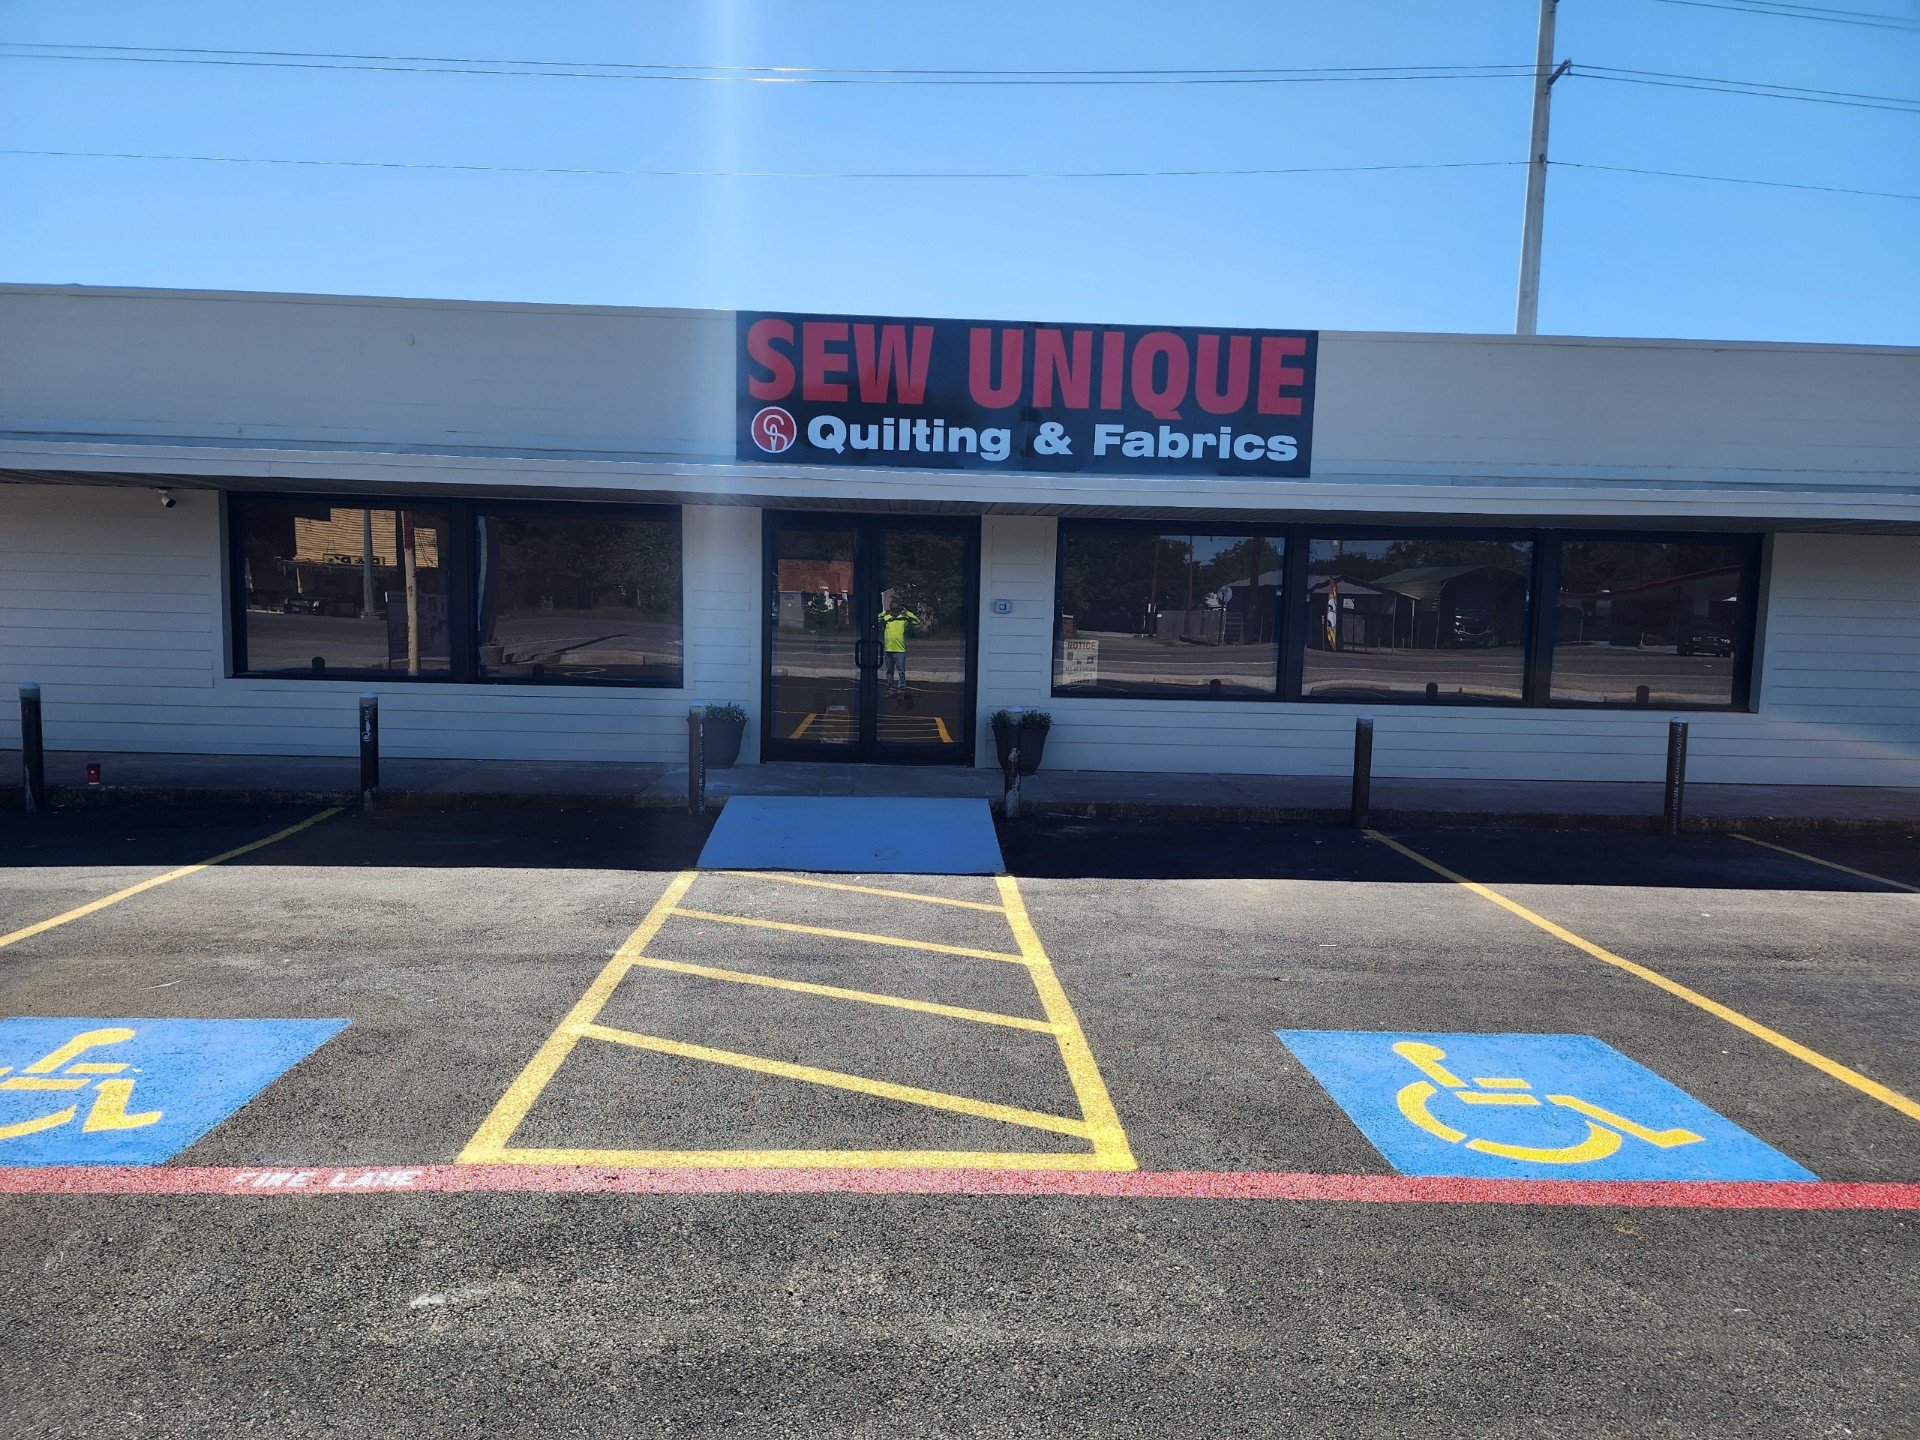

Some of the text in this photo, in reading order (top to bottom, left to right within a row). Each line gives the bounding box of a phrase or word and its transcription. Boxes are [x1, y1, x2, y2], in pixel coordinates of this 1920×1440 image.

[747, 318, 1307, 421] SEW UNIQUE
[807, 414, 1298, 462] Quilting & Fabrics
[1067, 641, 1096, 650] NOTICE
[231, 1169, 423, 1187] FIRE LANE
